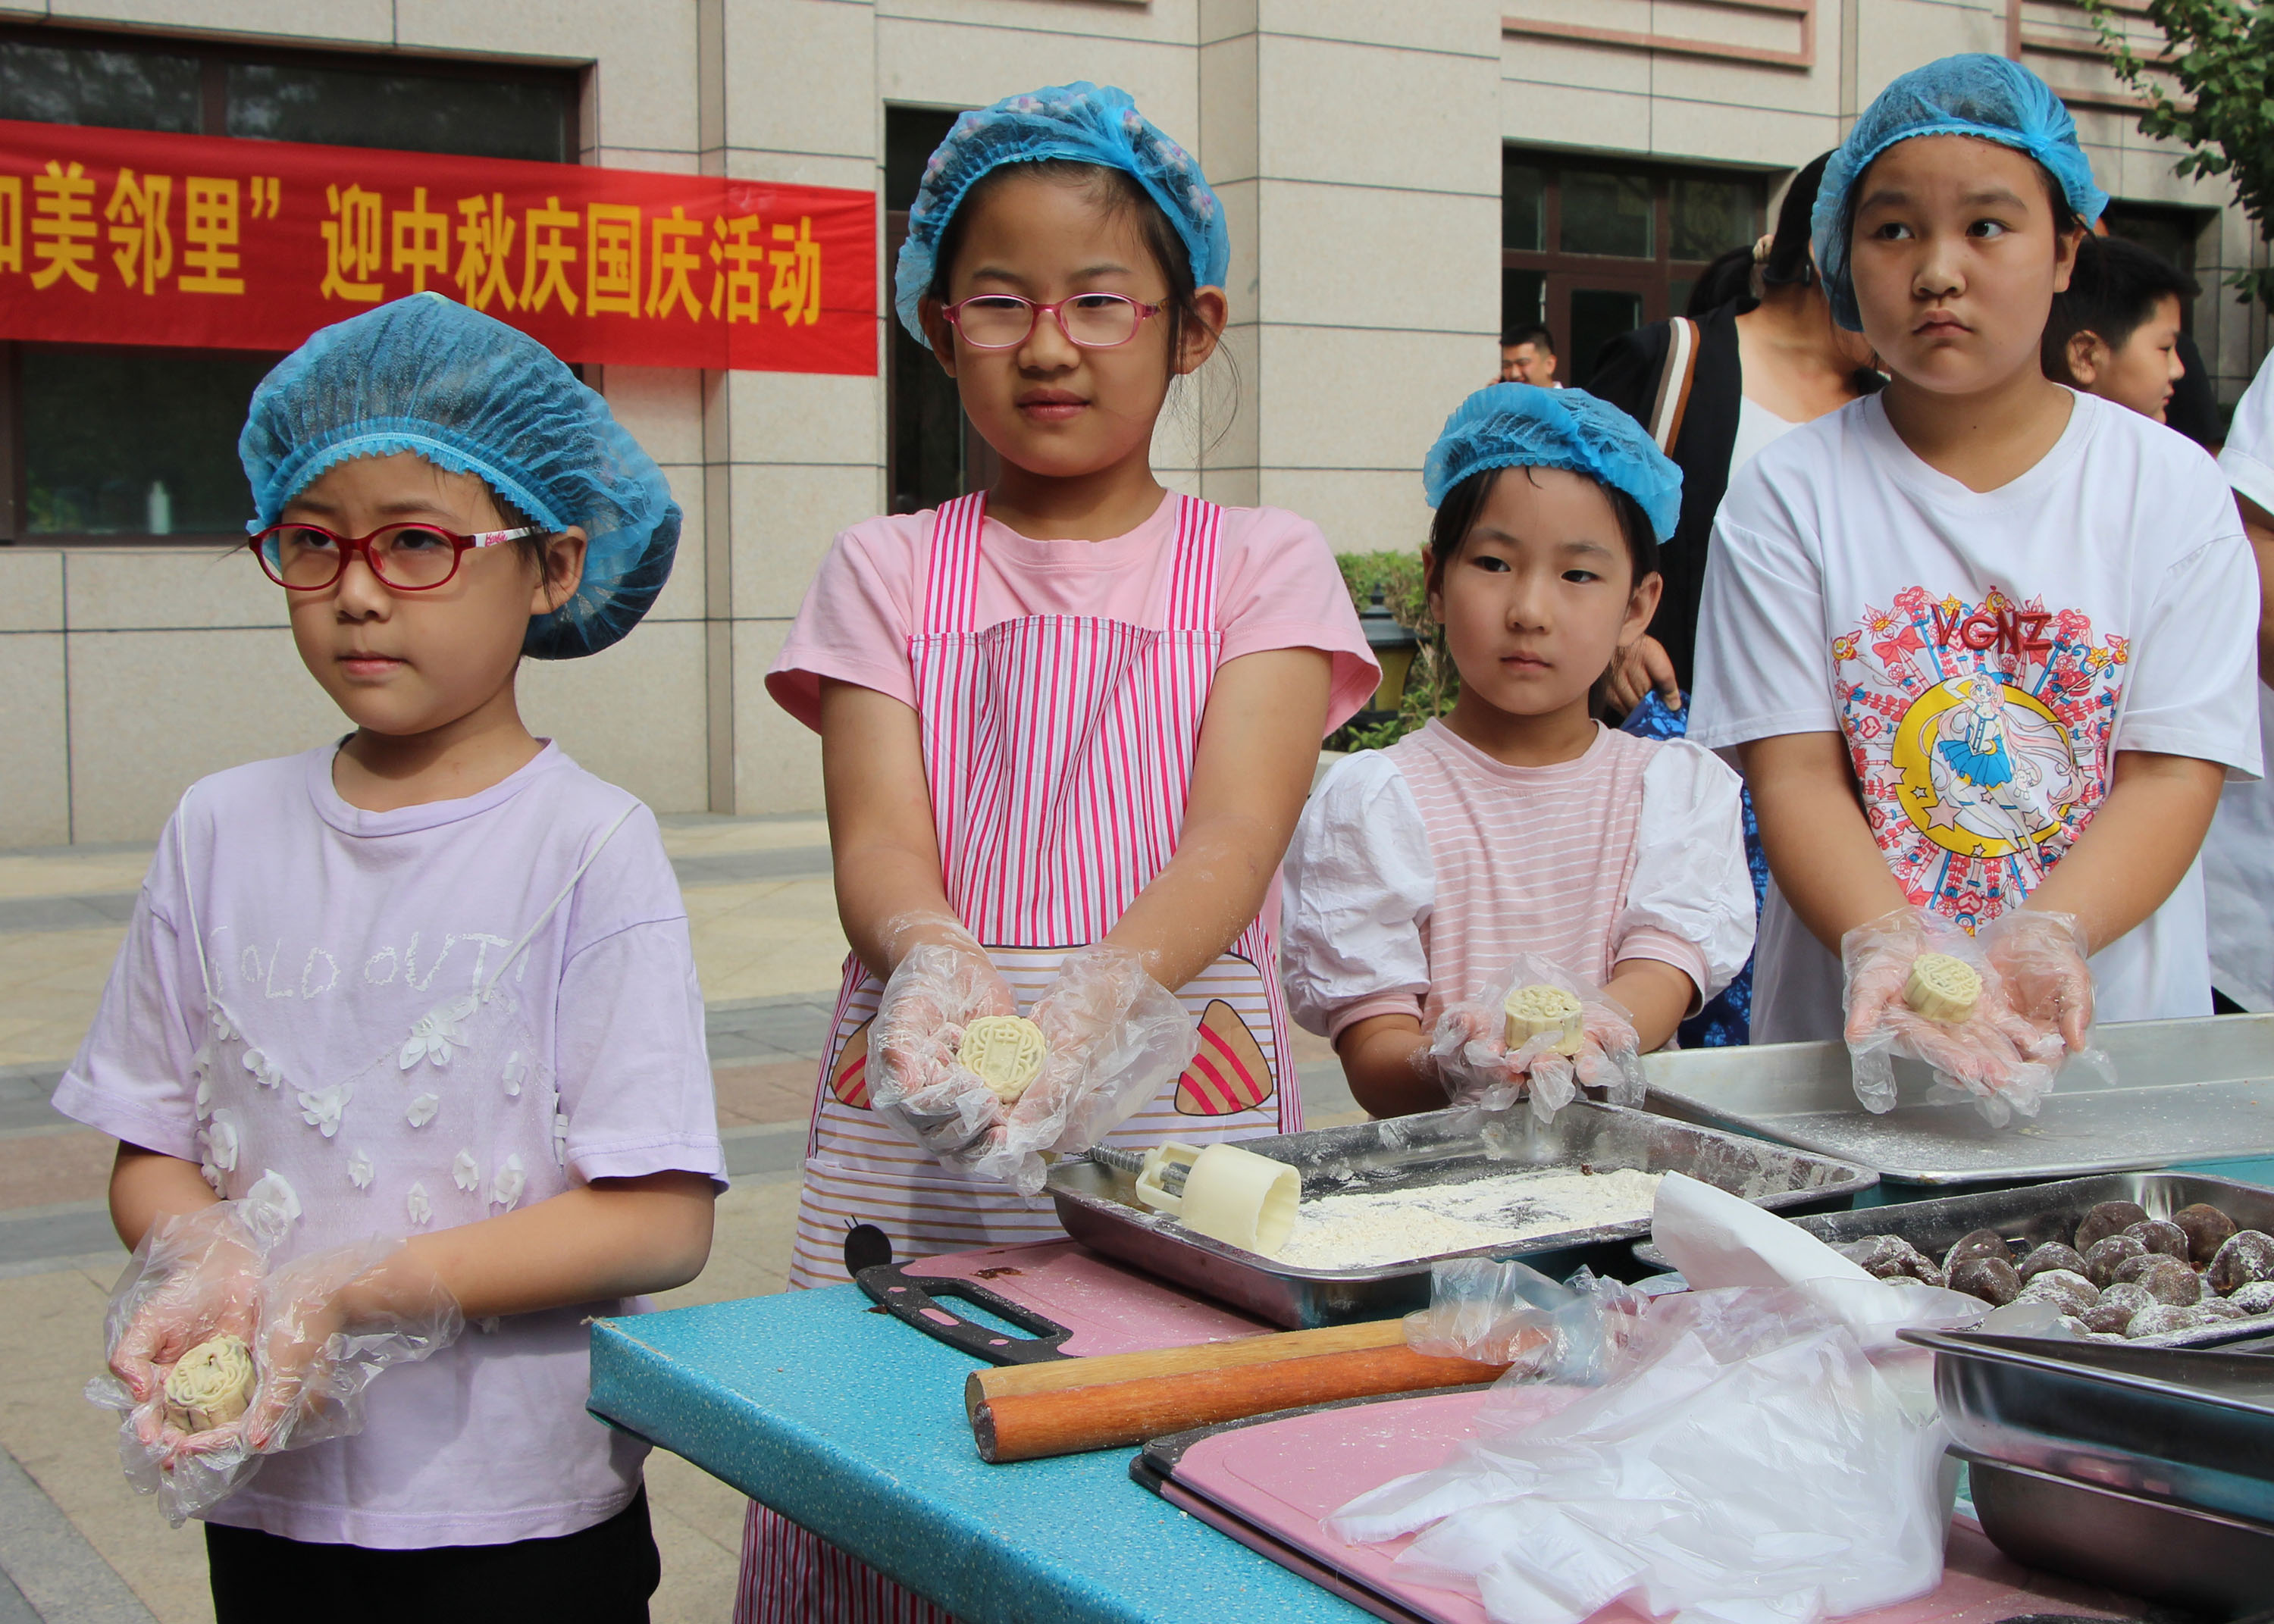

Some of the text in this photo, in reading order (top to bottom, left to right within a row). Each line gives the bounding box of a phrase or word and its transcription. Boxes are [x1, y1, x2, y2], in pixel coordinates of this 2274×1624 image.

[321, 184, 821, 327] 迎中秋庆国庆活动
[1931, 604, 2053, 655] VGNZ
